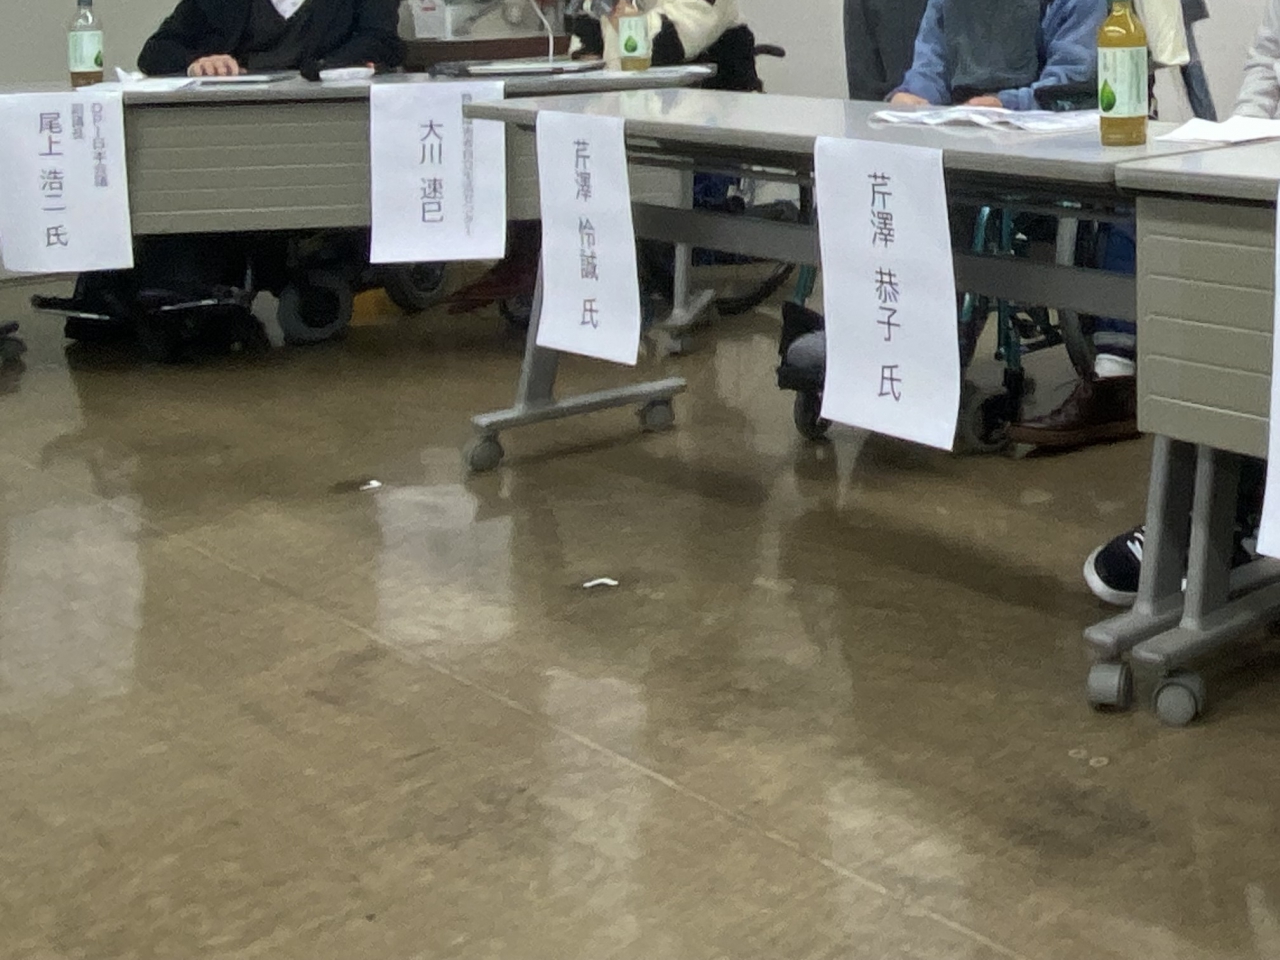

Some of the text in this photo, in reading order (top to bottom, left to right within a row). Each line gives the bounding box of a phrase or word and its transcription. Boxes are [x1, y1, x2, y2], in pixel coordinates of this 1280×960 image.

[420, 120, 443, 165] 大川
[574, 139, 592, 202] 芹澤
[39, 112, 68, 247] 尾上 浩二 氏
[580, 298, 598, 329] 氏
[867, 172, 902, 402] 芹澤 恭子 氏
